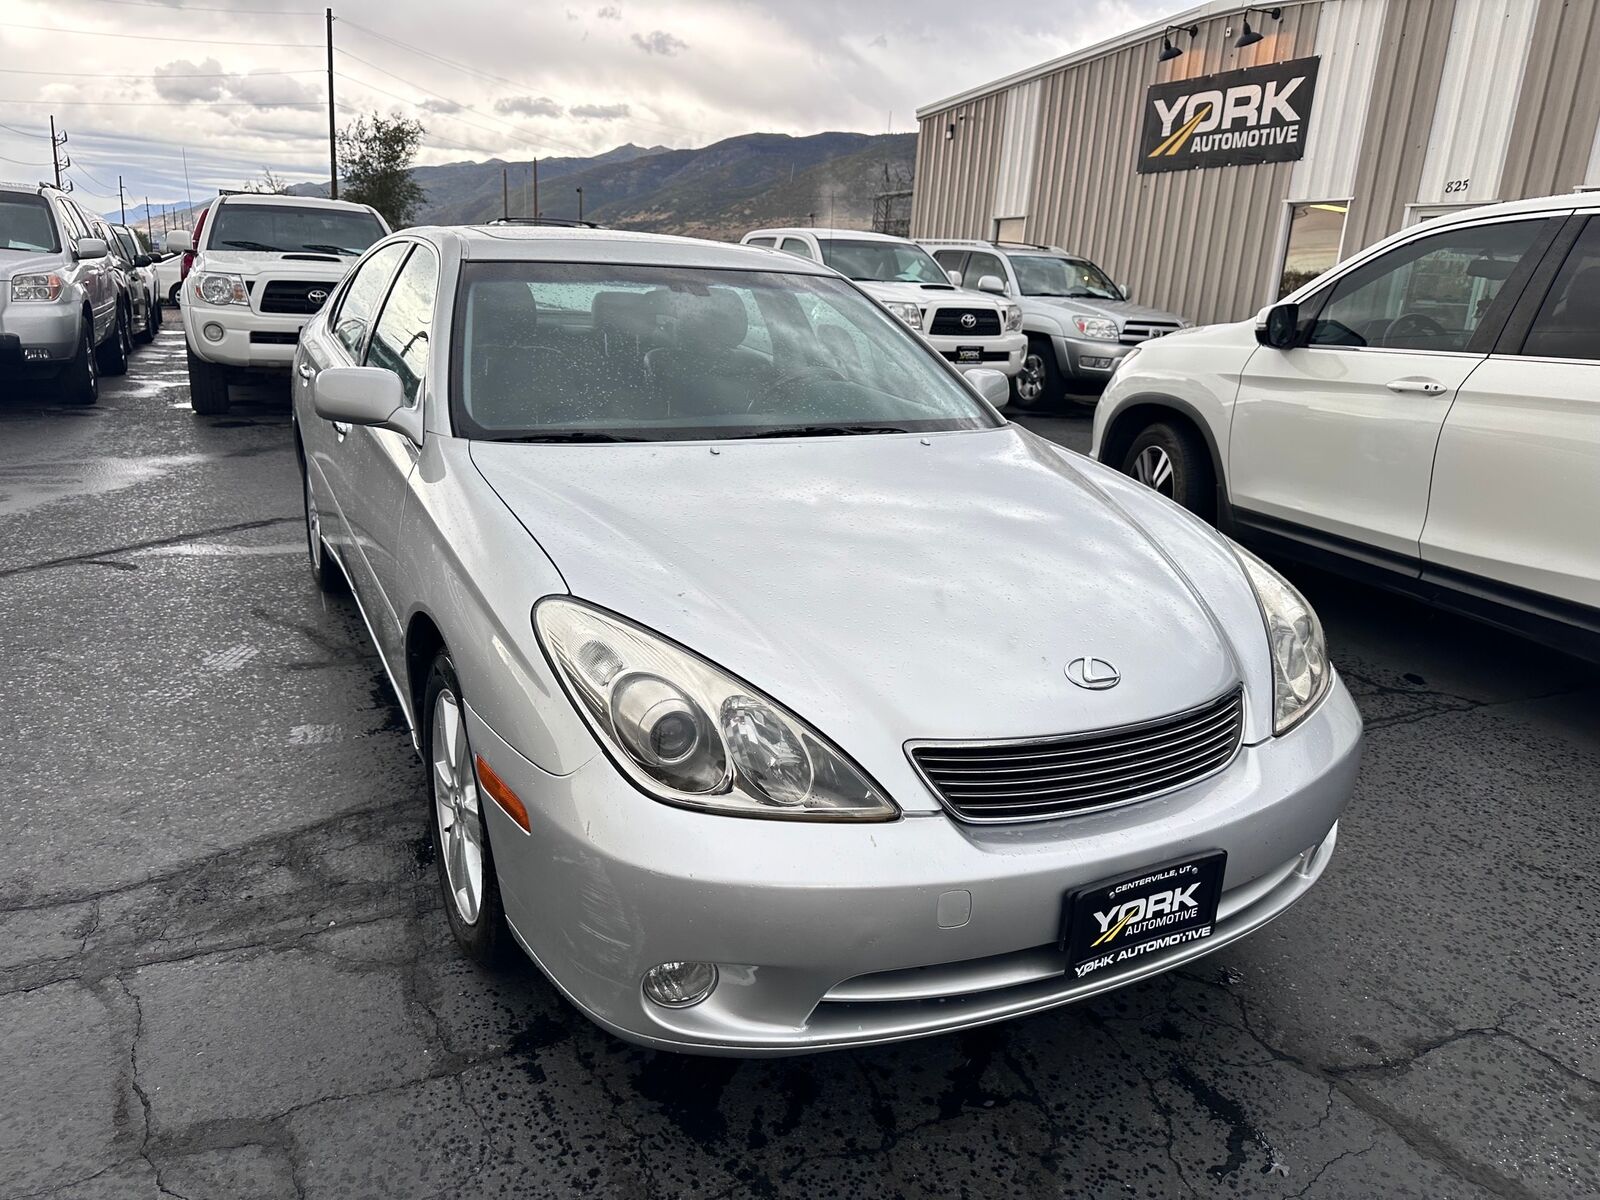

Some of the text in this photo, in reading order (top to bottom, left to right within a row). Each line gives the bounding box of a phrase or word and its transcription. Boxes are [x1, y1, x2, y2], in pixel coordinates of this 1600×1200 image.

[1153, 76, 1306, 137] YORK
[1190, 125, 1299, 153] AUTOMOTIVE
[1445, 179, 1470, 193] 825
[1115, 865, 1192, 893] CENTERVILLE, UT
[1093, 882, 1201, 933] YORK
[1125, 907, 1198, 936] AUTOMOTIVE
[1117, 926, 1211, 962] AUTOMOTIVE
